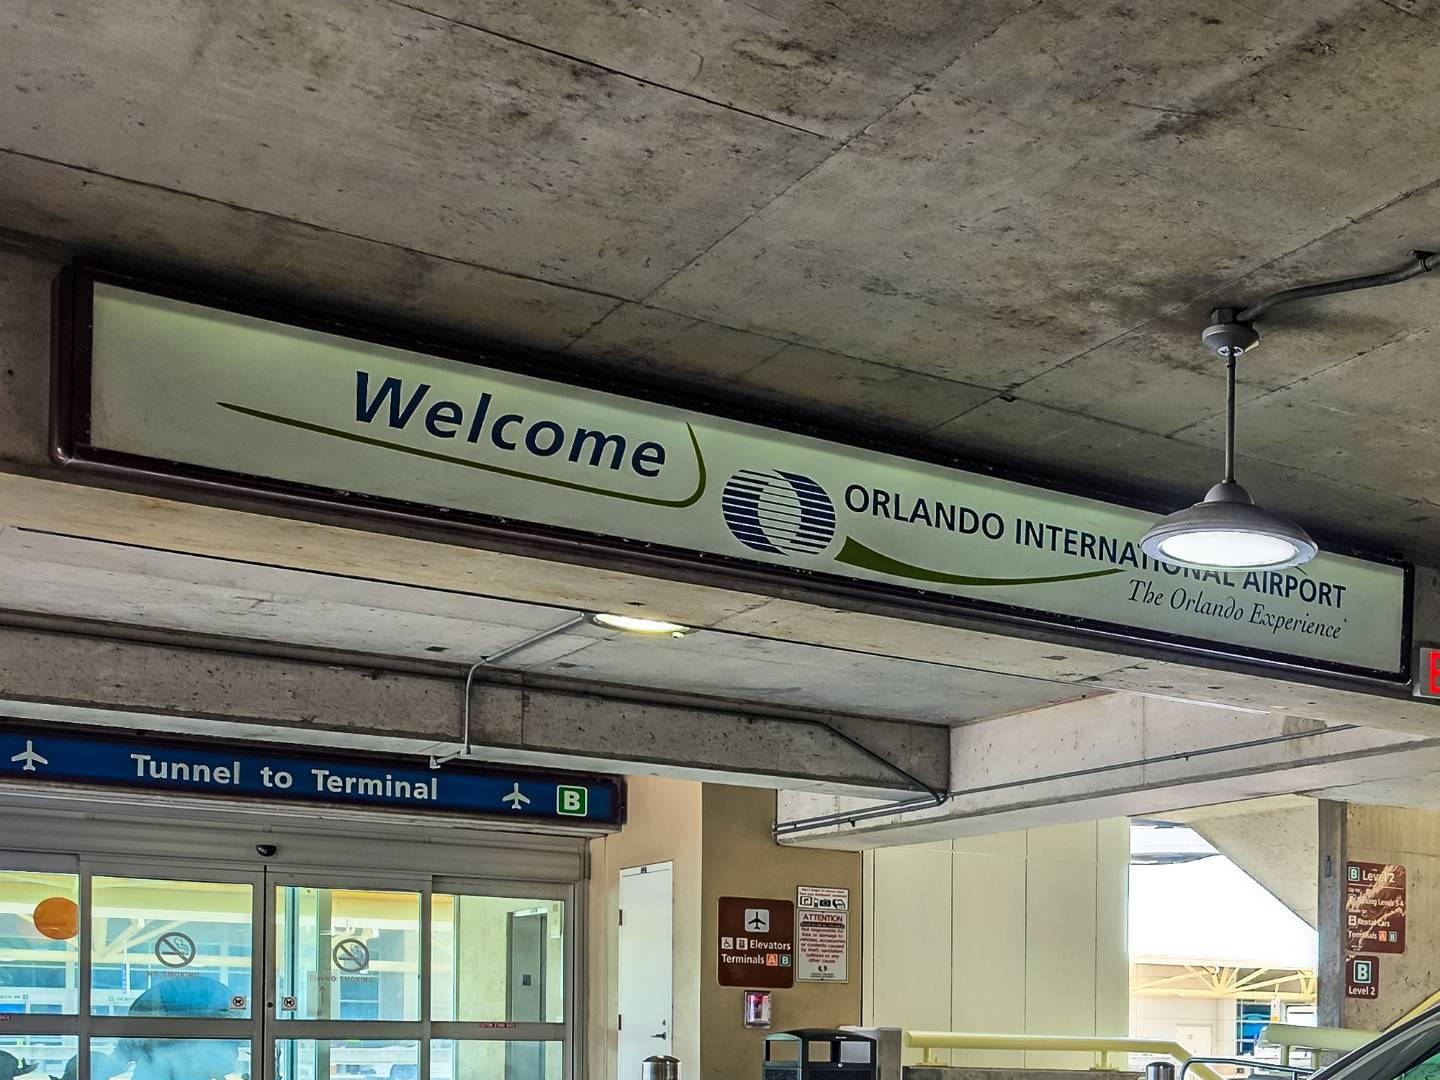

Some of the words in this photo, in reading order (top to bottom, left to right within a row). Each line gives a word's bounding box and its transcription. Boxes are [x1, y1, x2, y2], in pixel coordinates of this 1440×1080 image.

[354, 371, 667, 478] Welcome
[844, 483, 1005, 541] ORLANDO
[1243, 571, 1346, 609] AIRPORT
[1128, 579, 1164, 606] The
[1170, 587, 1244, 620] Orlando
[1249, 602, 1342, 639] Experience
[130, 753, 240, 785] Tunnel
[260, 765, 293, 790] to
[311, 769, 438, 801] Terminal
[563, 791, 581, 811] B
[1350, 869, 1358, 879] B
[1362, 869, 1387, 883] Lev
[1389, 873, 1396, 883] 2
[803, 913, 843, 922] ATTENTION
[749, 939, 791, 950] Elevators
[720, 953, 765, 965] Terminals
[768, 955, 776, 964] A
[781, 955, 789, 965] B
[1357, 963, 1368, 980] B
[1348, 985, 1369, 996] Level
[1370, 986, 1376, 996] 2
